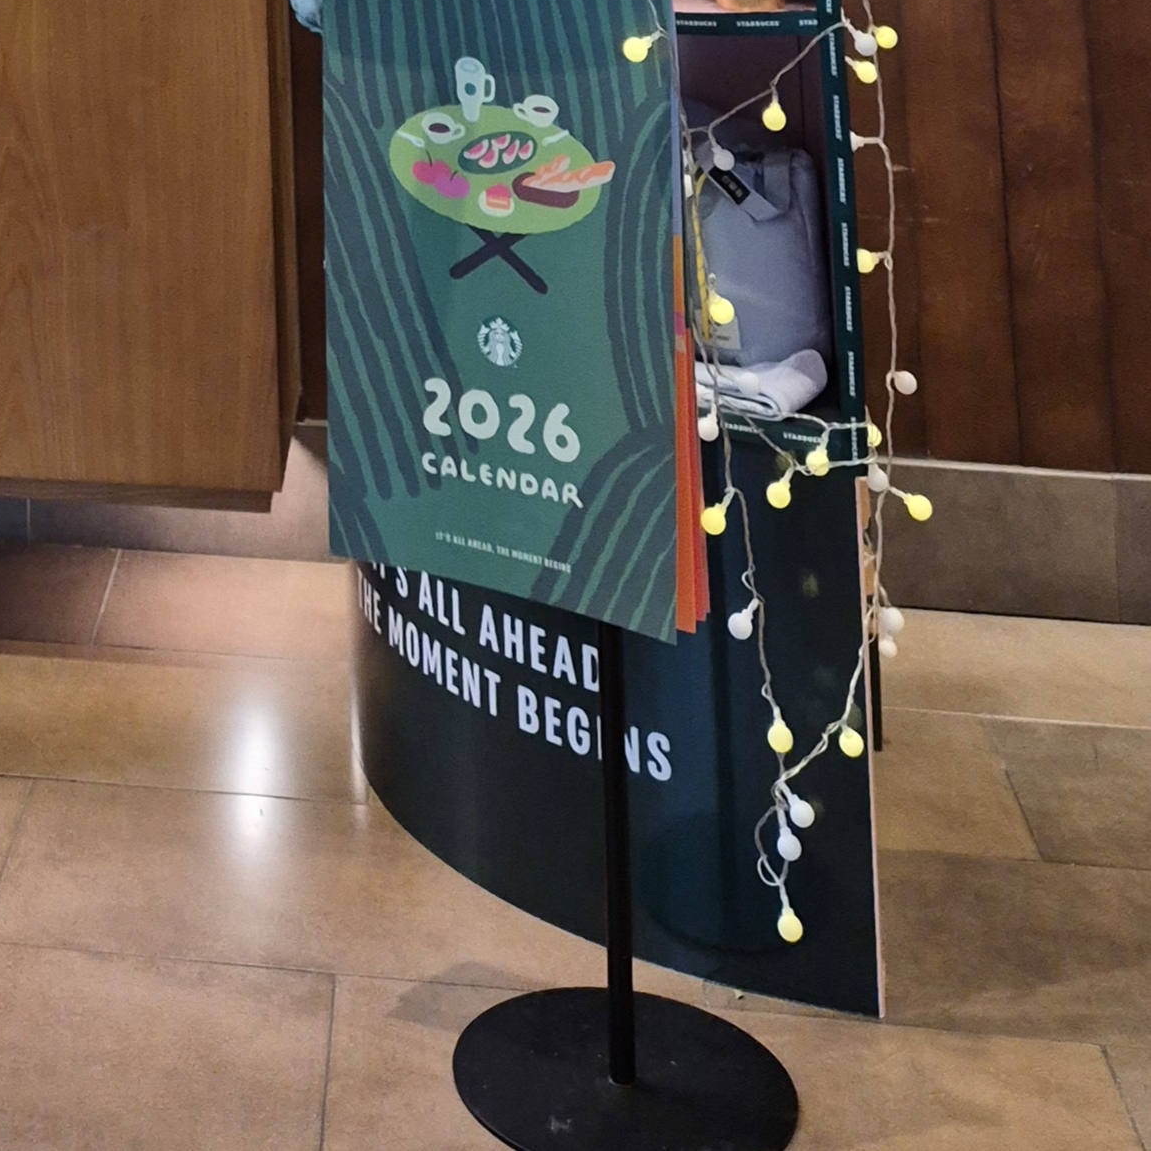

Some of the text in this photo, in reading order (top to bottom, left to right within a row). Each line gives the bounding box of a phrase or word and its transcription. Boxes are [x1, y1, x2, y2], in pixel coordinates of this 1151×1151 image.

[423, 377, 581, 463] 2026
[422, 452, 584, 509] CALENDAR
[453, 535, 466, 546] ALL
[496, 545, 510, 557] THE
[511, 549, 543, 565] MOMENT
[544, 557, 571, 573] BEGINS
[357, 567, 382, 635] THE
[388, 602, 501, 717] MOMENT
[418, 570, 466, 636] ALL
[479, 604, 600, 693] AHEAD
